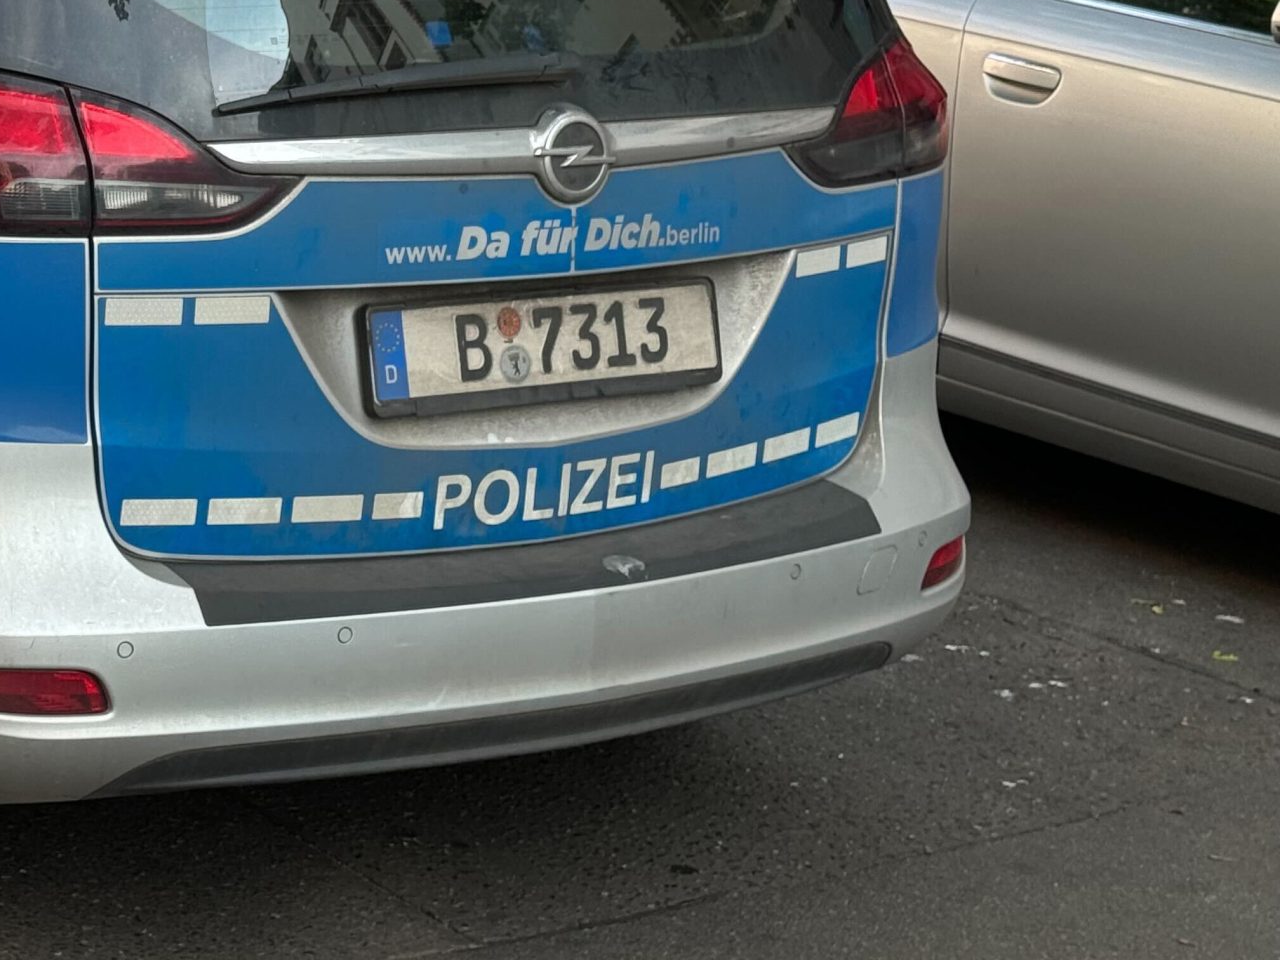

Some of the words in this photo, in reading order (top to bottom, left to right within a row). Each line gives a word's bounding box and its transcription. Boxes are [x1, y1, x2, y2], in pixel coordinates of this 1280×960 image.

[521, 219, 578, 256] für
[385, 364, 398, 384] D
[454, 313, 493, 382] B
[532, 297, 669, 374] 7313
[433, 450, 655, 530] POLIZEI
